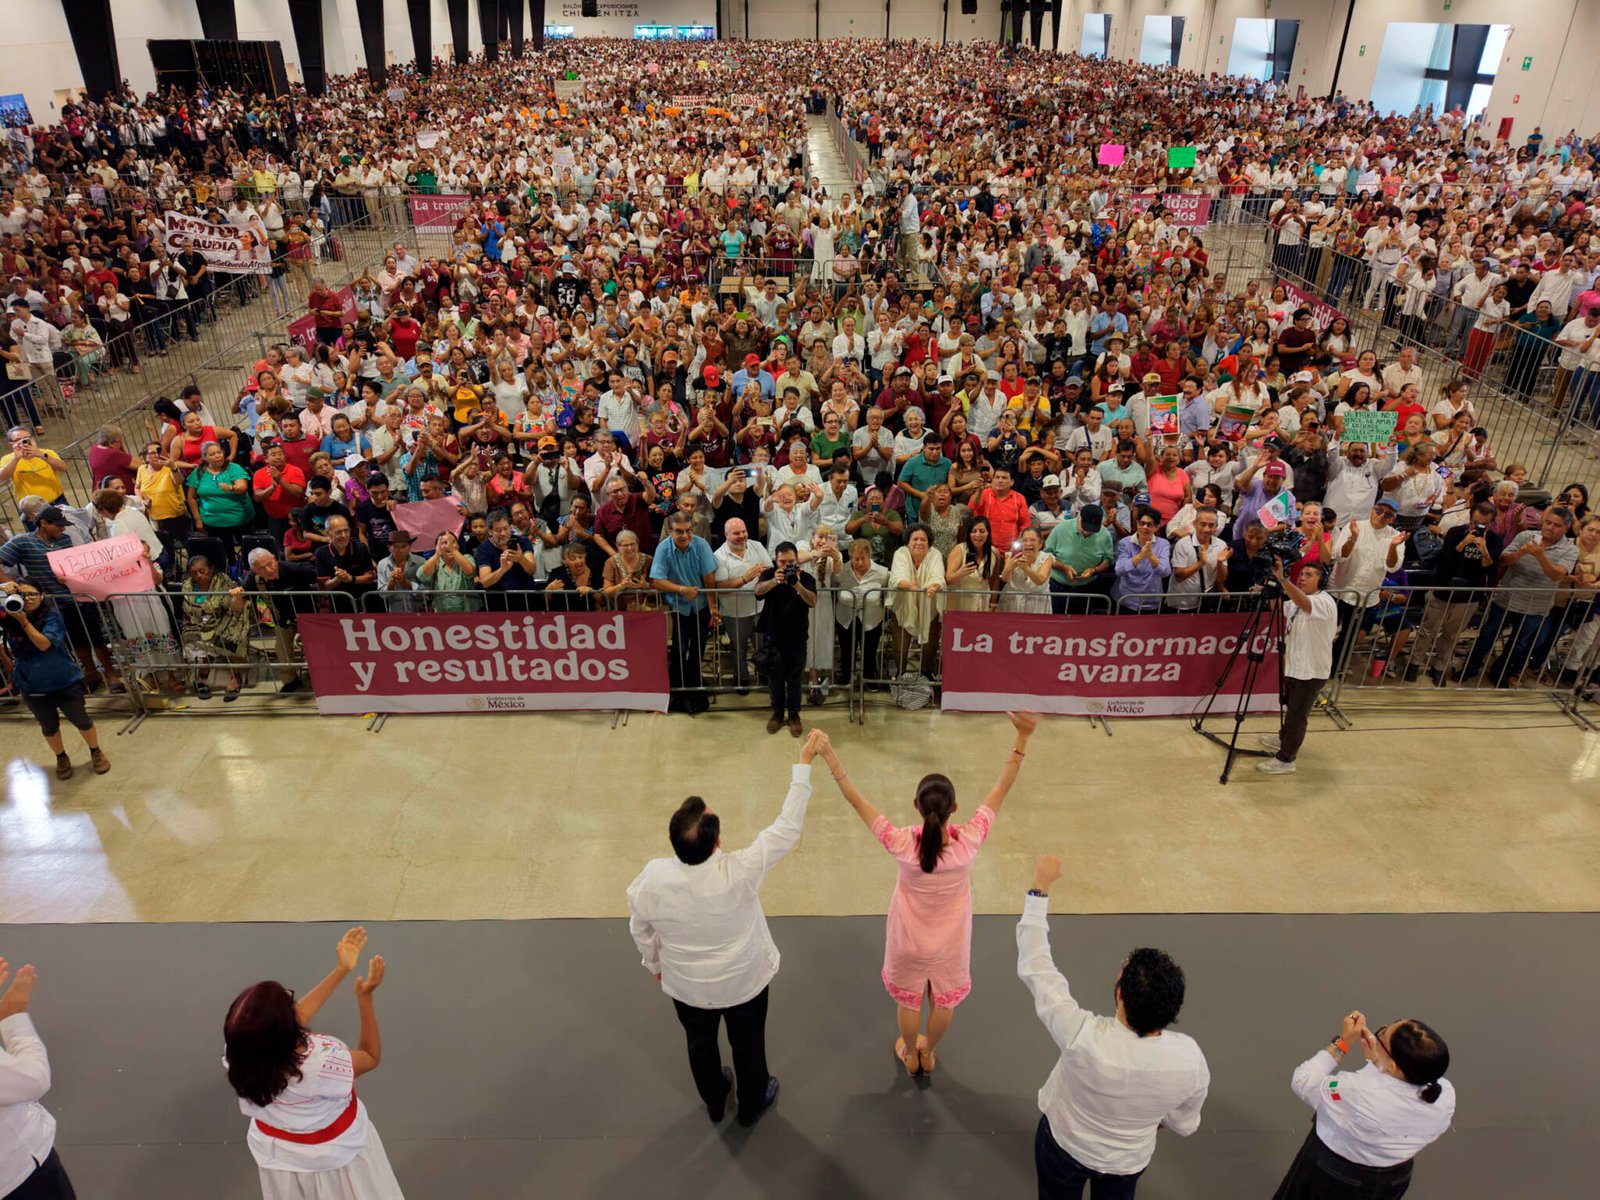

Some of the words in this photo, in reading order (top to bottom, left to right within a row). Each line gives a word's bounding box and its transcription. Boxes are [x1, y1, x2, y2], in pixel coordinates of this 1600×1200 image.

[562, 9, 610, 17] CHIEN
[413, 200, 429, 211] La
[167, 215, 242, 240] MOTUL
[167, 233, 239, 252] CAUDIA
[339, 614, 627, 651] Honestidad
[951, 627, 994, 653] La
[350, 661, 377, 692] y
[394, 651, 630, 683] resultados
[1057, 661, 1182, 683] avanza
[487, 700, 526, 709] México
[1106, 704, 1145, 713] México
